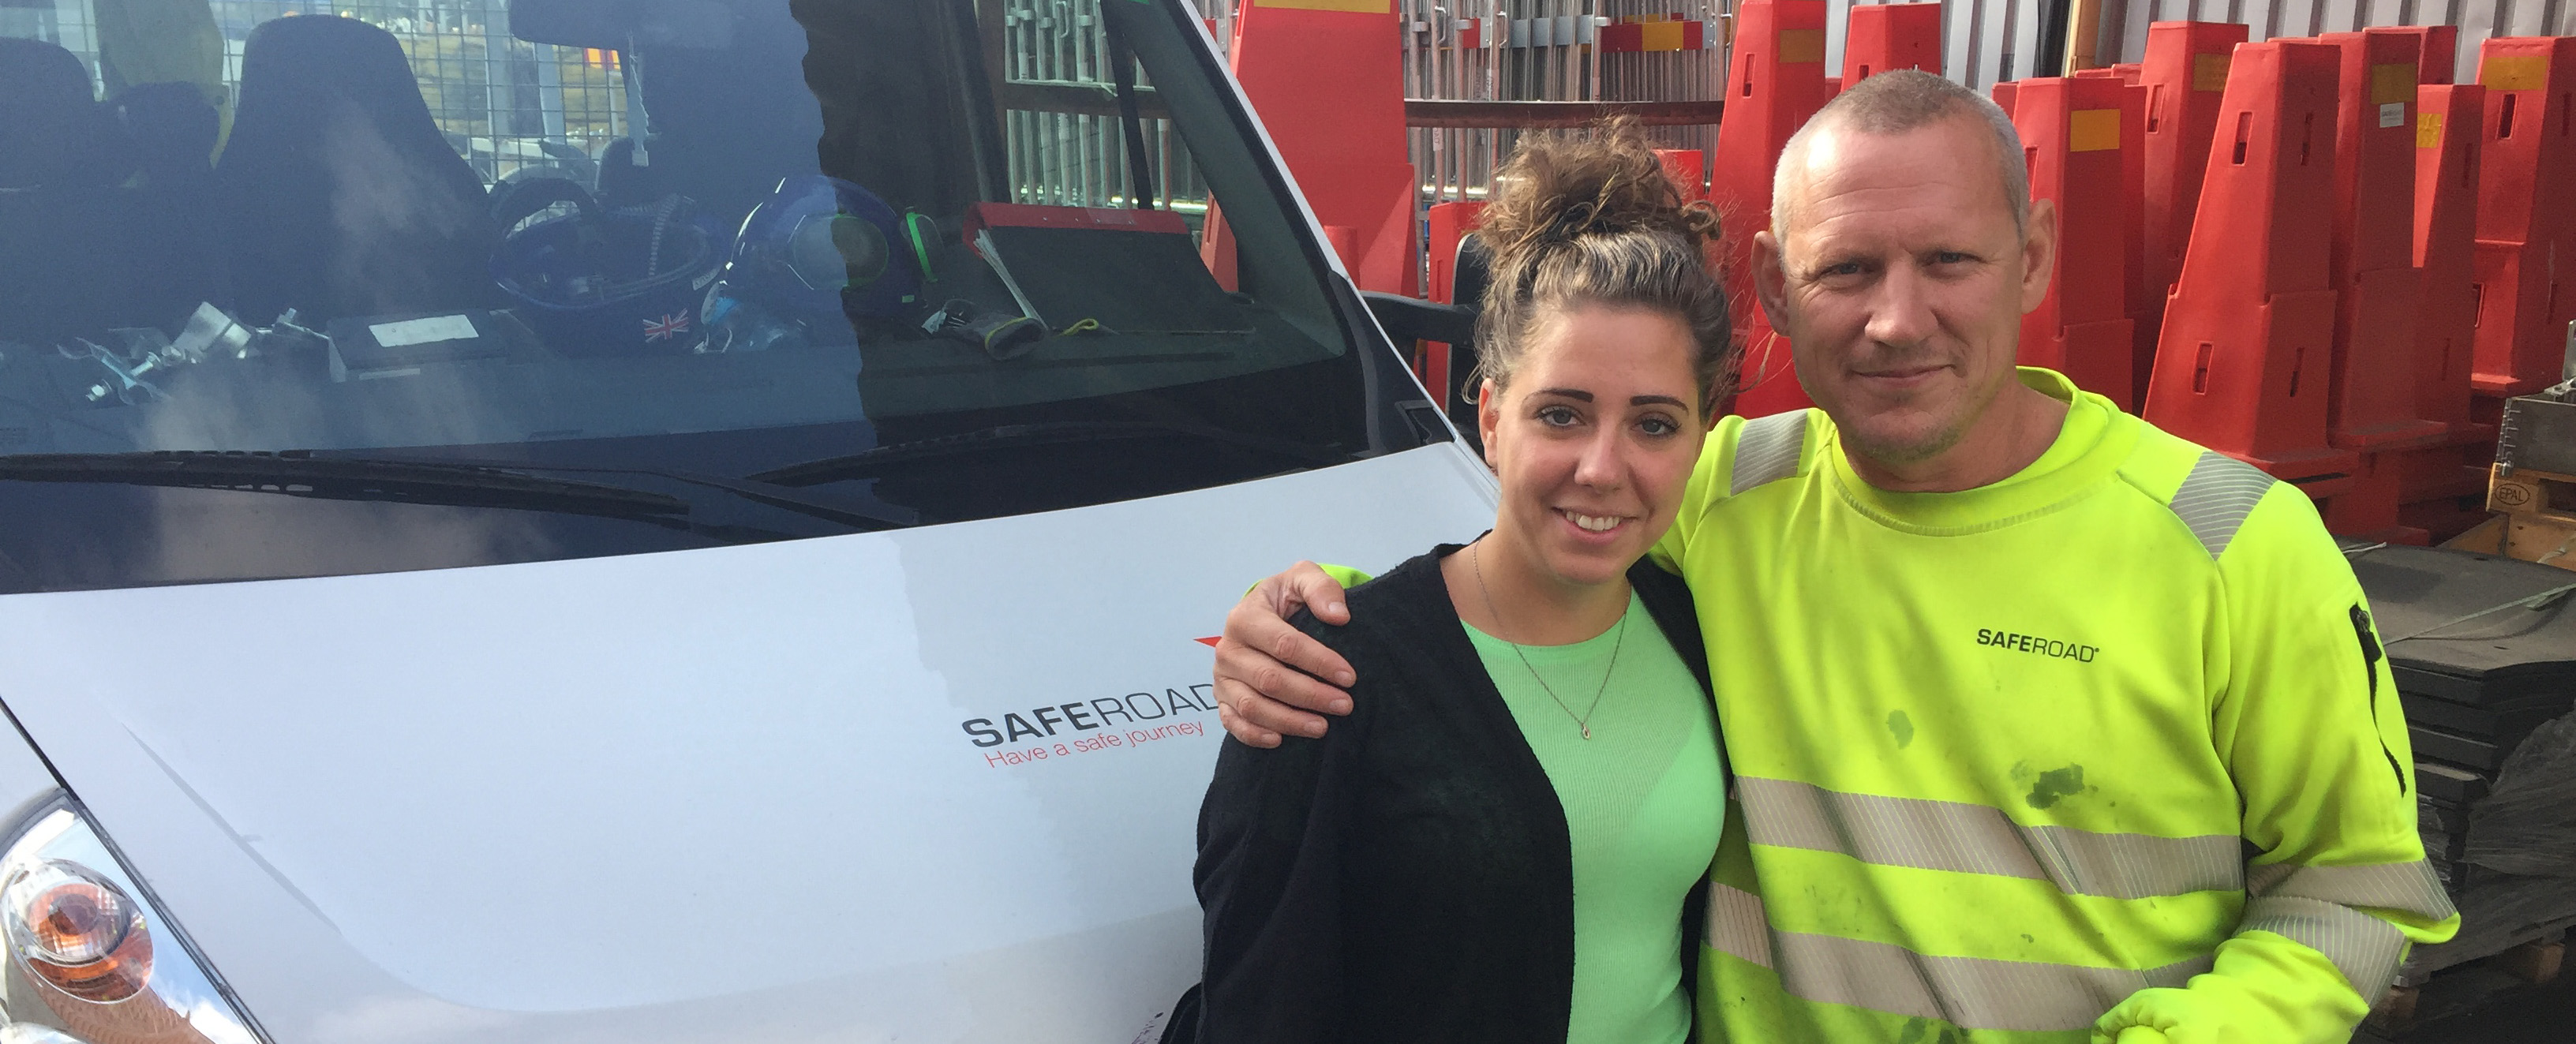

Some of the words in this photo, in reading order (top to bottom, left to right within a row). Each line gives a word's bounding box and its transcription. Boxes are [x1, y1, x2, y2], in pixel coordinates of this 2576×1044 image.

[2499, 488, 2524, 502] EPAL
[1977, 629, 2096, 663] SAFEROAD
[984, 747, 1048, 769] Have
[1054, 742, 1070, 755] a
[1074, 732, 1122, 752] safe
[1123, 720, 1204, 747] journey
